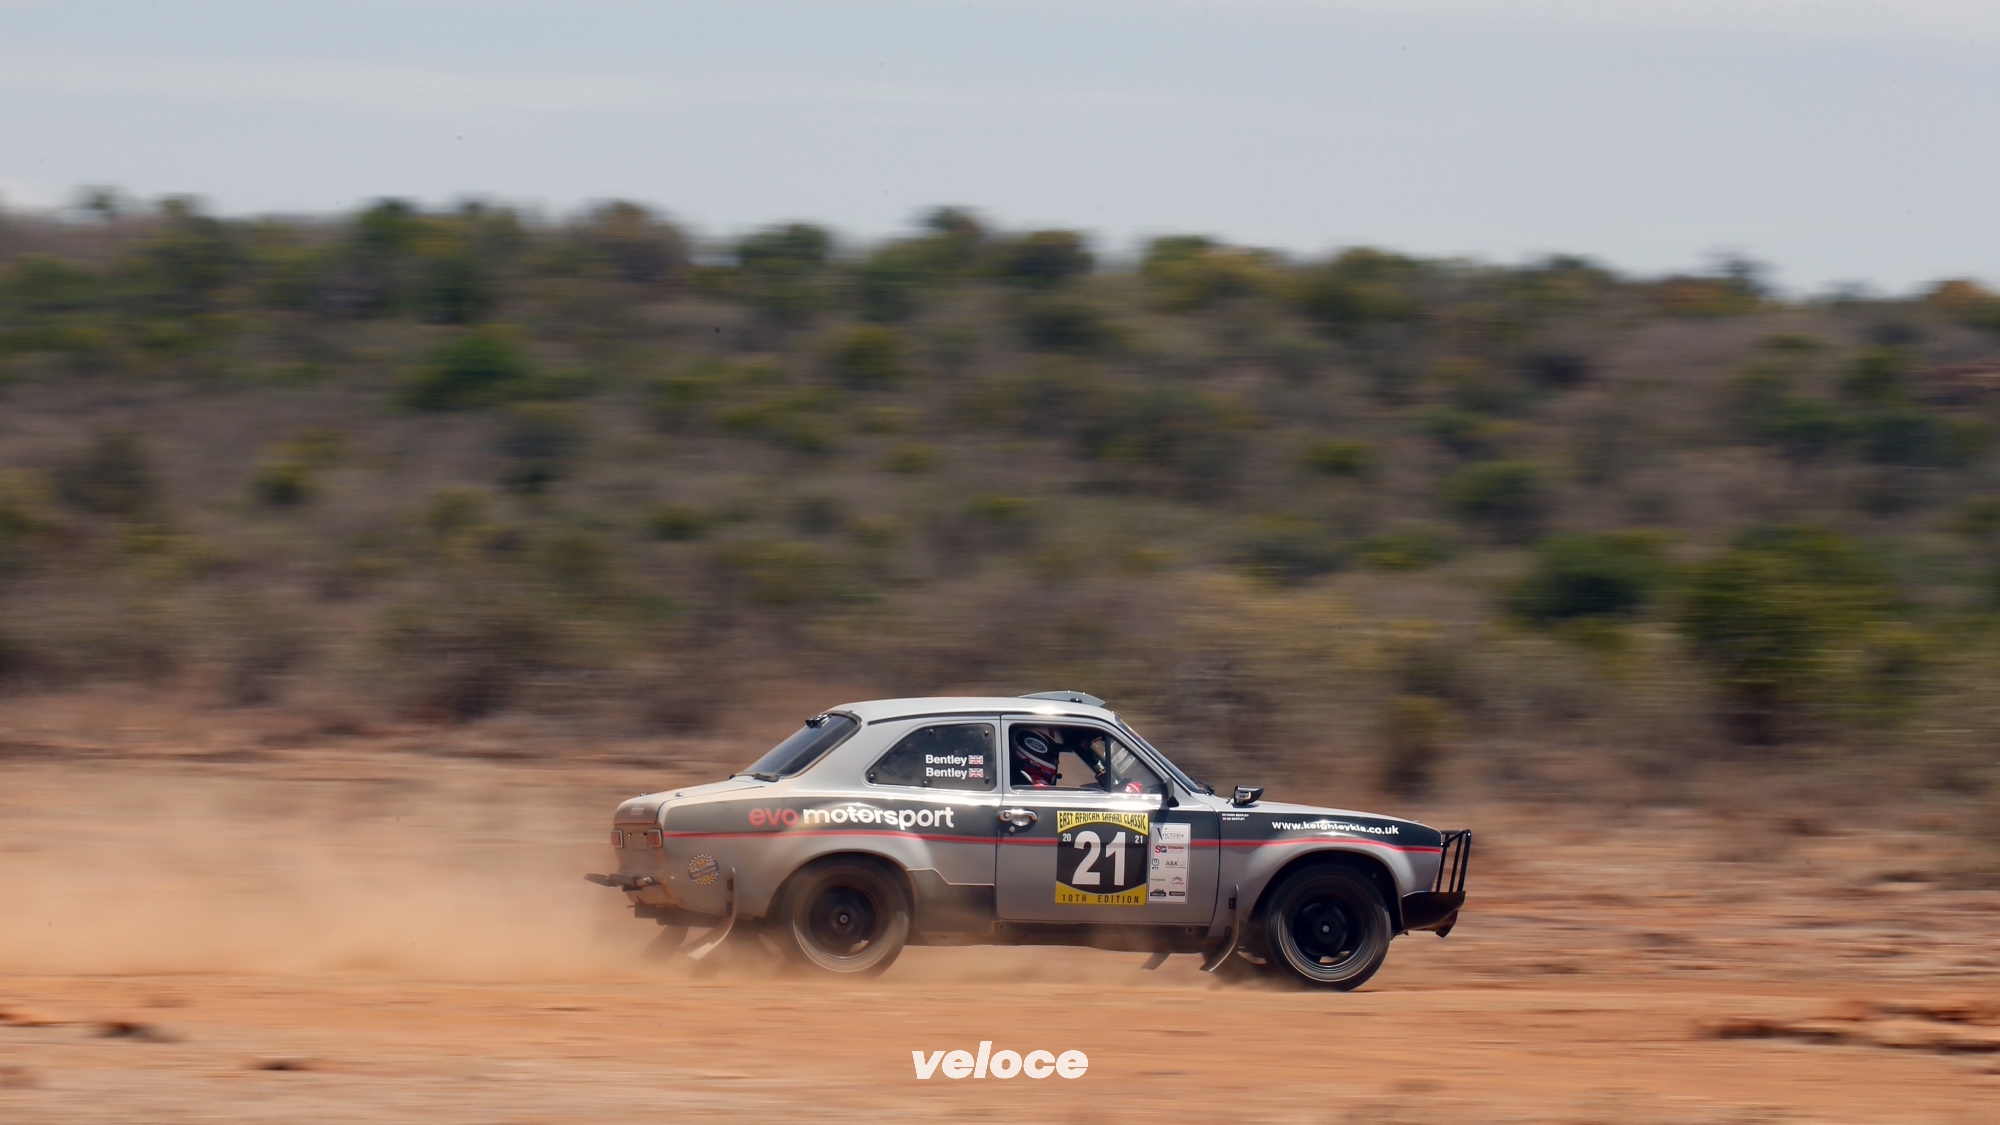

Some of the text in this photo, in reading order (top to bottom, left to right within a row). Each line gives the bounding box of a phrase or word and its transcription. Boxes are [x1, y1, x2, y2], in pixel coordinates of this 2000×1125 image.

[925, 754, 968, 767] Bentley
[925, 767, 968, 780] Bentley
[749, 806, 955, 830] evo motorsport
[1059, 812, 1146, 831] EAST AFRICAN SAFARI CLASSIC
[1272, 820, 1400, 835] www.keighleykia.co.uk
[1062, 833, 1072, 842] 20
[1134, 835, 1143, 844] 21
[1071, 830, 1126, 886] 21
[1062, 894, 1140, 904] 10TH EDITION
